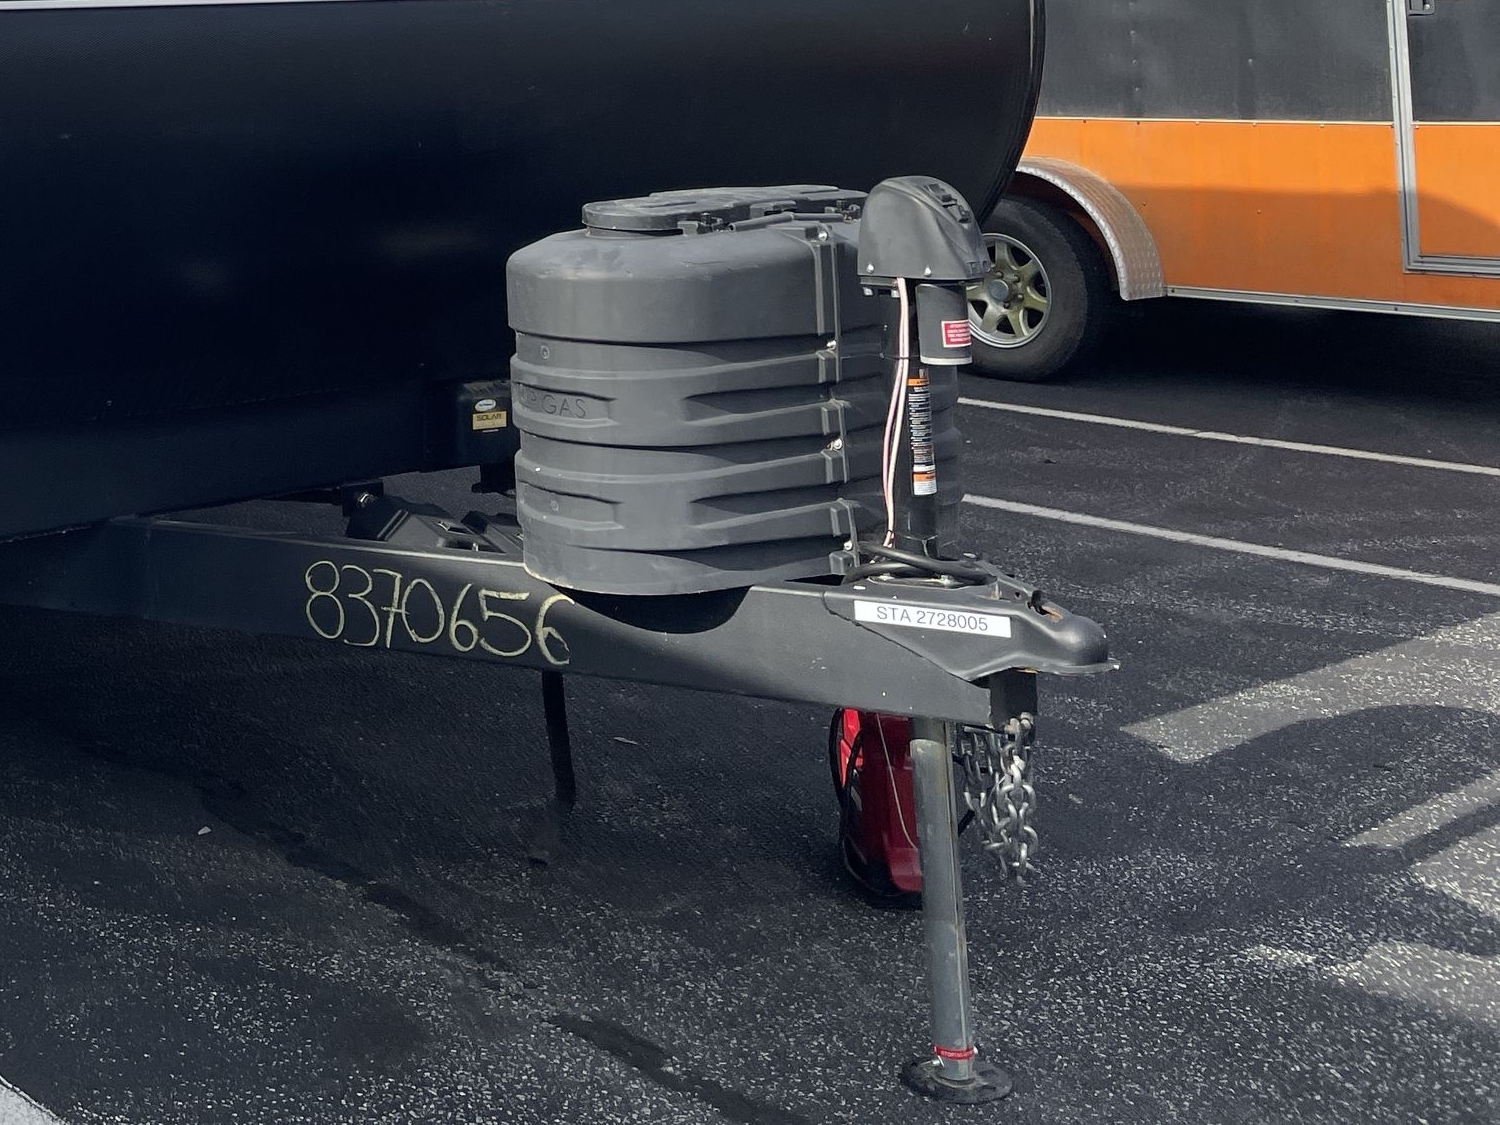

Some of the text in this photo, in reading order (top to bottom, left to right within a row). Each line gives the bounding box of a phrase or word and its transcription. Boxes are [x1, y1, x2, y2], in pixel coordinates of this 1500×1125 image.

[476, 413, 502, 422] SOLAR
[541, 393, 586, 419] GAS
[305, 560, 575, 665] 8370656
[876, 605, 989, 632] STA 2728005
